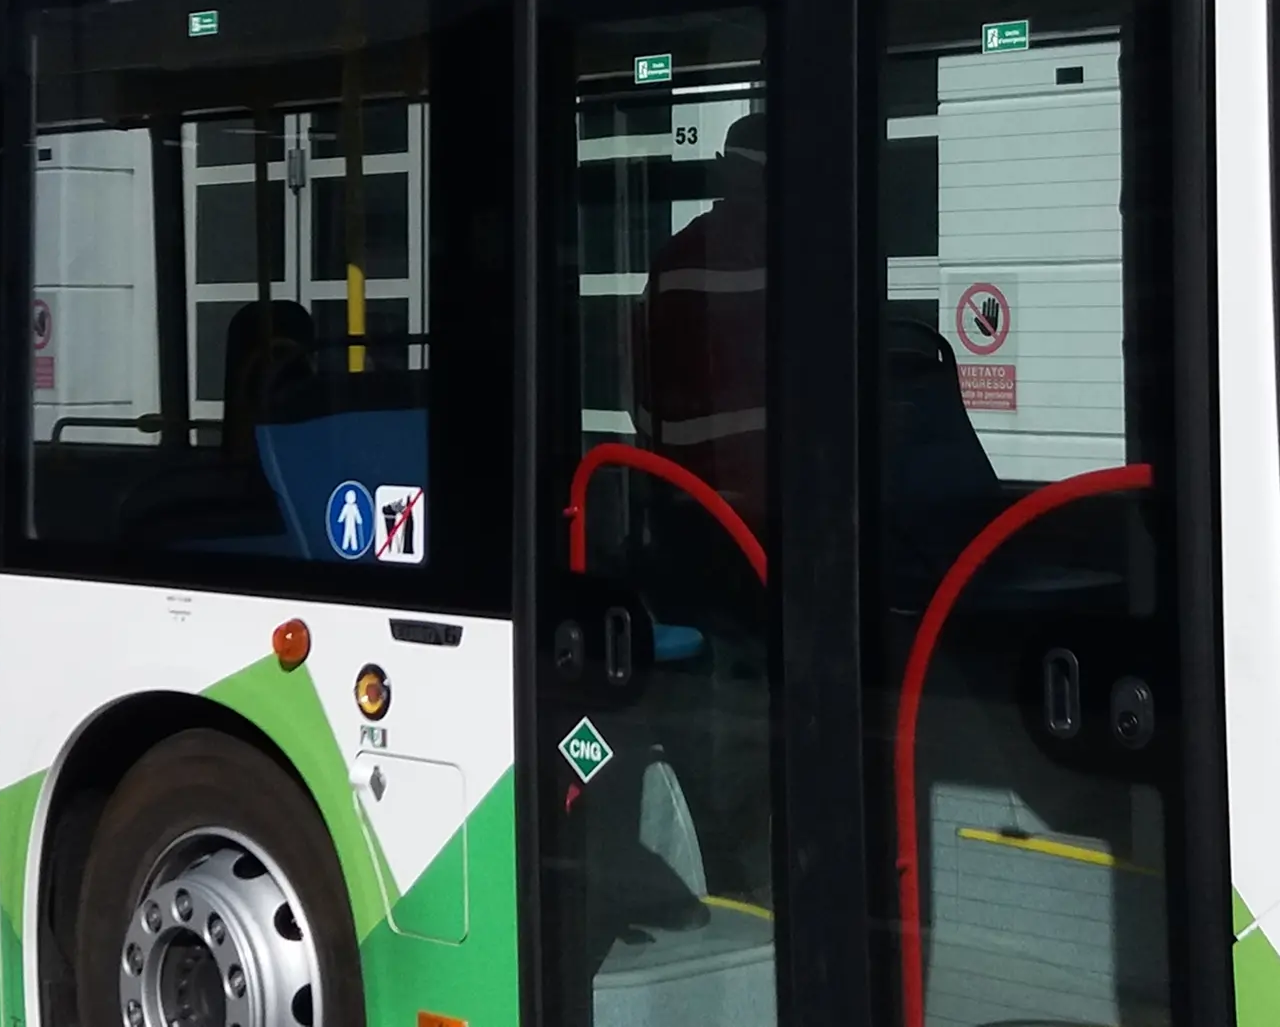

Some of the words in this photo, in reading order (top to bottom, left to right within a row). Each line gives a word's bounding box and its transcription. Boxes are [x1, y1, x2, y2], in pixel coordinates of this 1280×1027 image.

[675, 126, 698, 145] 53
[960, 366, 1006, 378] VIETATO
[569, 738, 602, 761] CNG
